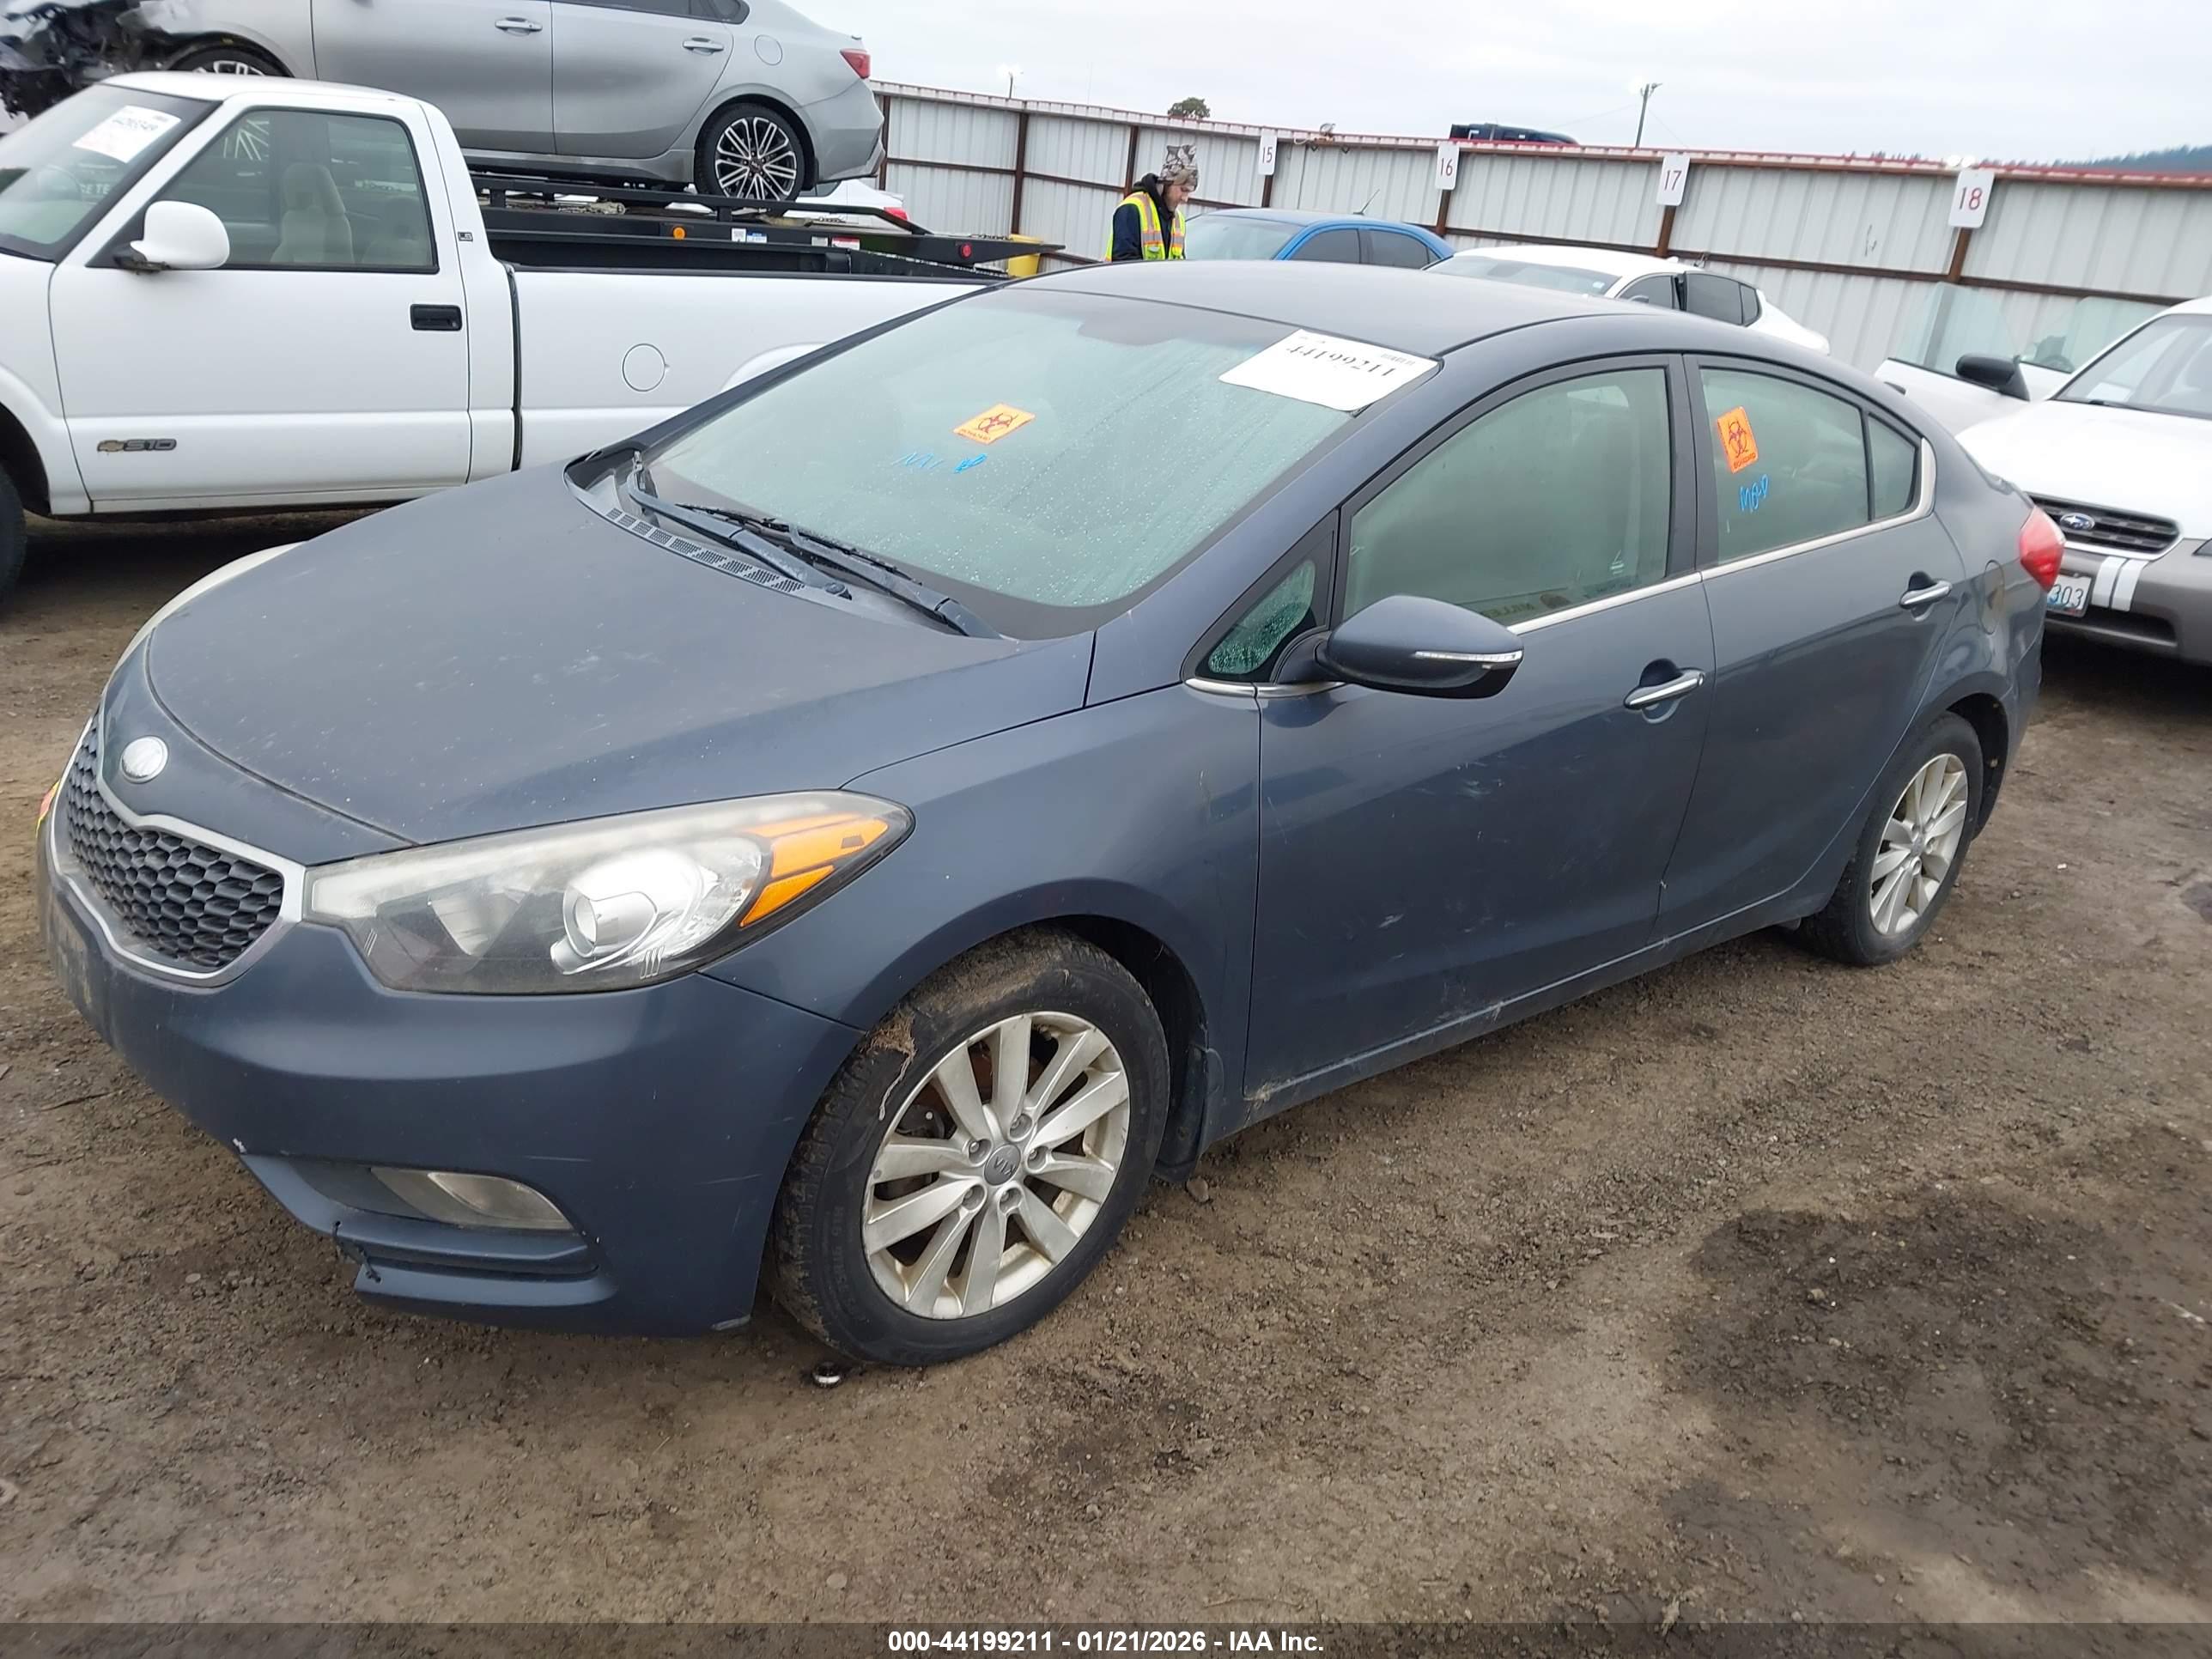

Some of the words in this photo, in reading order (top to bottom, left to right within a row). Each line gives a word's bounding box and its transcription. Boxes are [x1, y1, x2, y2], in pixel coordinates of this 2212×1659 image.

[1261, 146, 1273, 163] 15
[1440, 157, 1454, 177] 16
[1663, 169, 1682, 191] 17
[1959, 186, 1984, 210] 18
[124, 439, 177, 452] S10
[994, 1156, 1017, 1177] KIA
